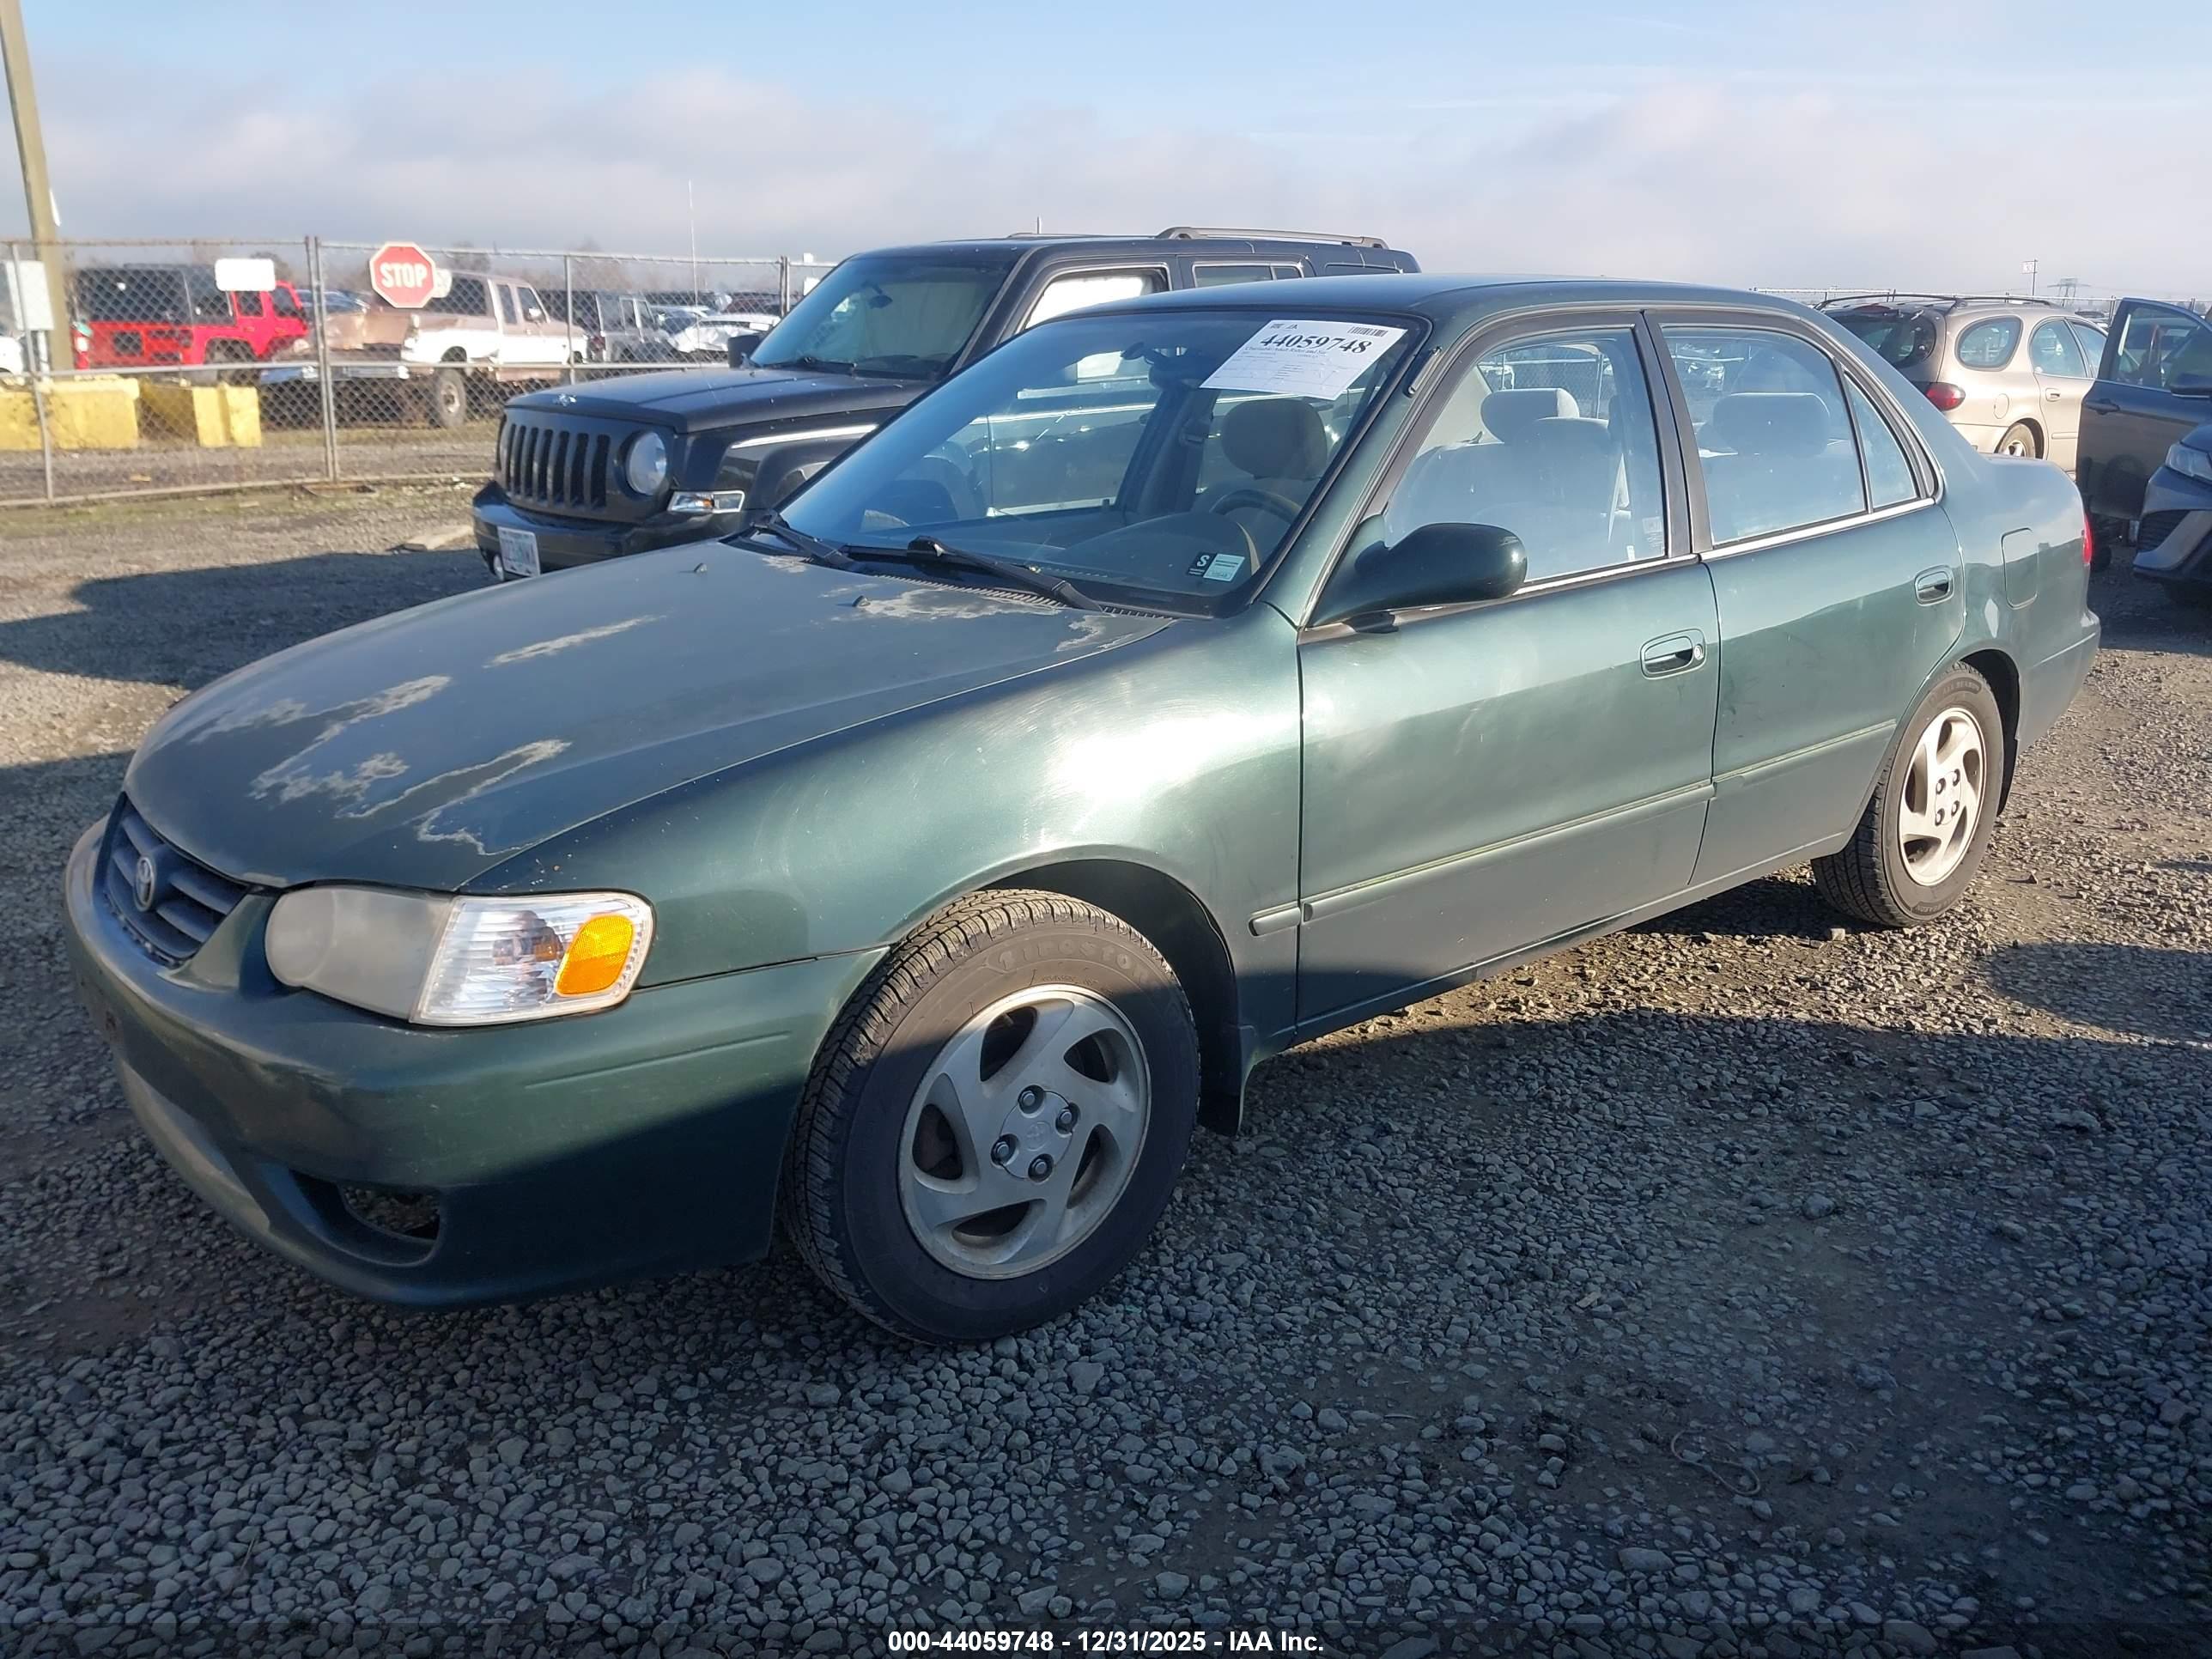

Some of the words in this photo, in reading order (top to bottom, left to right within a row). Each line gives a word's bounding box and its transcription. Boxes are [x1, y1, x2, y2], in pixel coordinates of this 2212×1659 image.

[380, 262, 428, 289] STOP
[1261, 333, 1372, 354] 44059748
[1196, 555, 1211, 567] S
